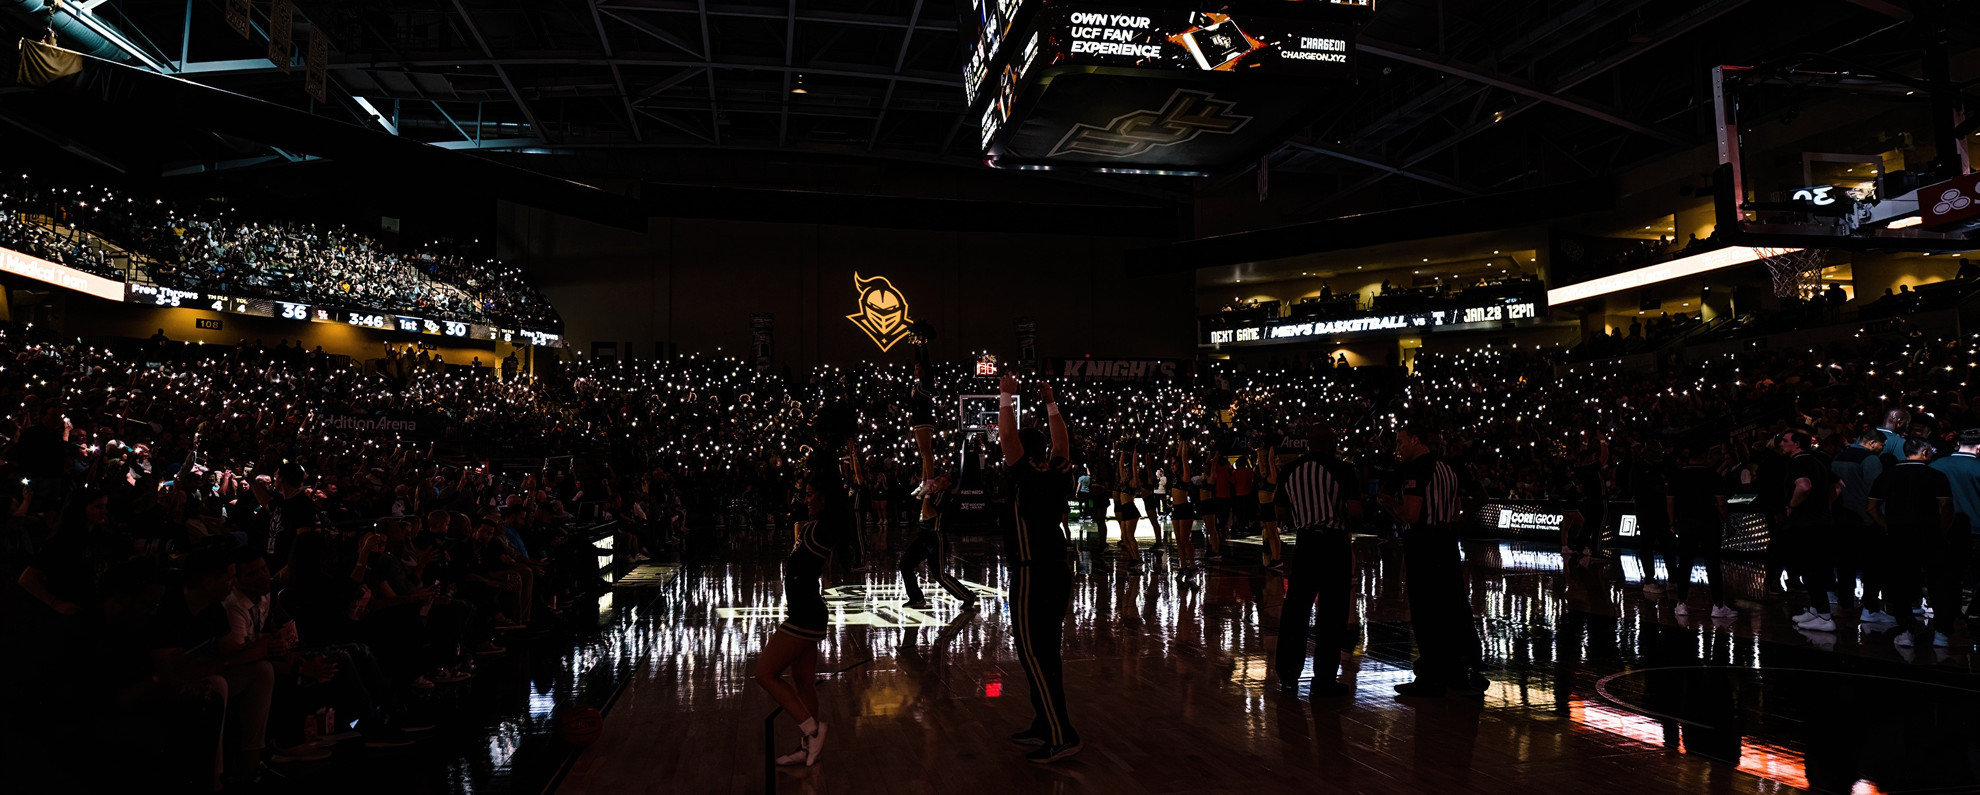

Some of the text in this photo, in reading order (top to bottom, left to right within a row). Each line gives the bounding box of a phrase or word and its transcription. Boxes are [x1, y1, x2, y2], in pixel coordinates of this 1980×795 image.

[1070, 12, 1151, 28] OWN YOUR
[1071, 26, 1133, 41] UCF FAN
[1071, 40, 1161, 57] EXPERIENCE
[1301, 36, 1346, 52] CHARGEON
[1281, 50, 1346, 63] CHARGEON.XYZ
[1046, 88, 1253, 157] UCF
[57, 269, 87, 290] Team
[132, 284, 199, 300] Free Throws
[211, 300, 223, 311] 4
[237, 304, 246, 313] 4
[282, 303, 306, 320] 36
[200, 320, 218, 328] 108
[349, 313, 384, 328] 3:46
[400, 320, 418, 331] 1st
[1211, 330, 1233, 343] NEXT
[1237, 328, 1260, 342] GAME
[1271, 323, 1314, 338] MEN'S
[1314, 315, 1407, 334] BASKETBALL
[1464, 306, 1502, 322] JAN.28
[1507, 303, 1535, 319] 12PM
[445, 323, 466, 337] 30
[490, 332, 496, 340] 3
[504, 333, 512, 342] 8
[520, 329, 559, 341] Free Throws
[1063, 359, 1177, 377] KNIGHTS
[375, 415, 416, 431] Arena
[1536, 513, 1564, 525] GROUP
